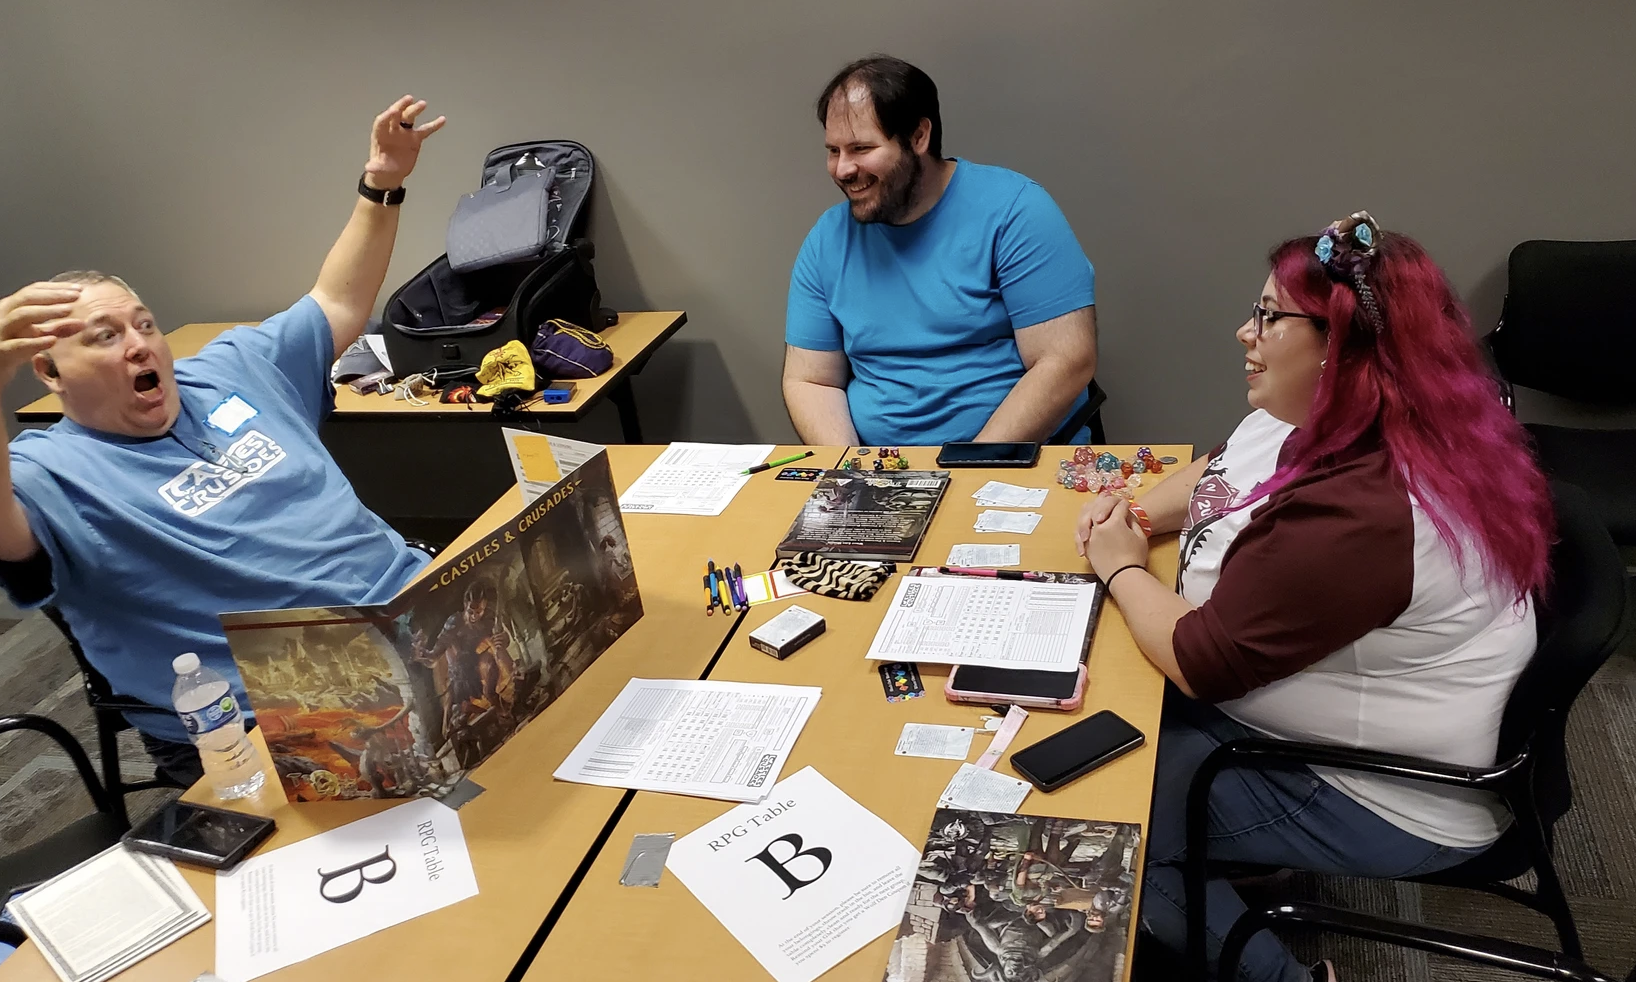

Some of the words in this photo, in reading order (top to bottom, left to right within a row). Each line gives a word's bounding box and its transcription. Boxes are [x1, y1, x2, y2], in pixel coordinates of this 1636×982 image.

[170, 438, 264, 498] CASES
[1205, 483, 1217, 492] 2
[440, 538, 500, 586] CASTLES
[504, 530, 516, 544] &
[518, 481, 574, 533] CRUSADES
[417, 820, 437, 847] RPG
[707, 825, 748, 852] RPG
[746, 799, 797, 828] Table
[317, 844, 397, 904] B
[423, 845, 444, 881] Table
[744, 833, 833, 901] B
